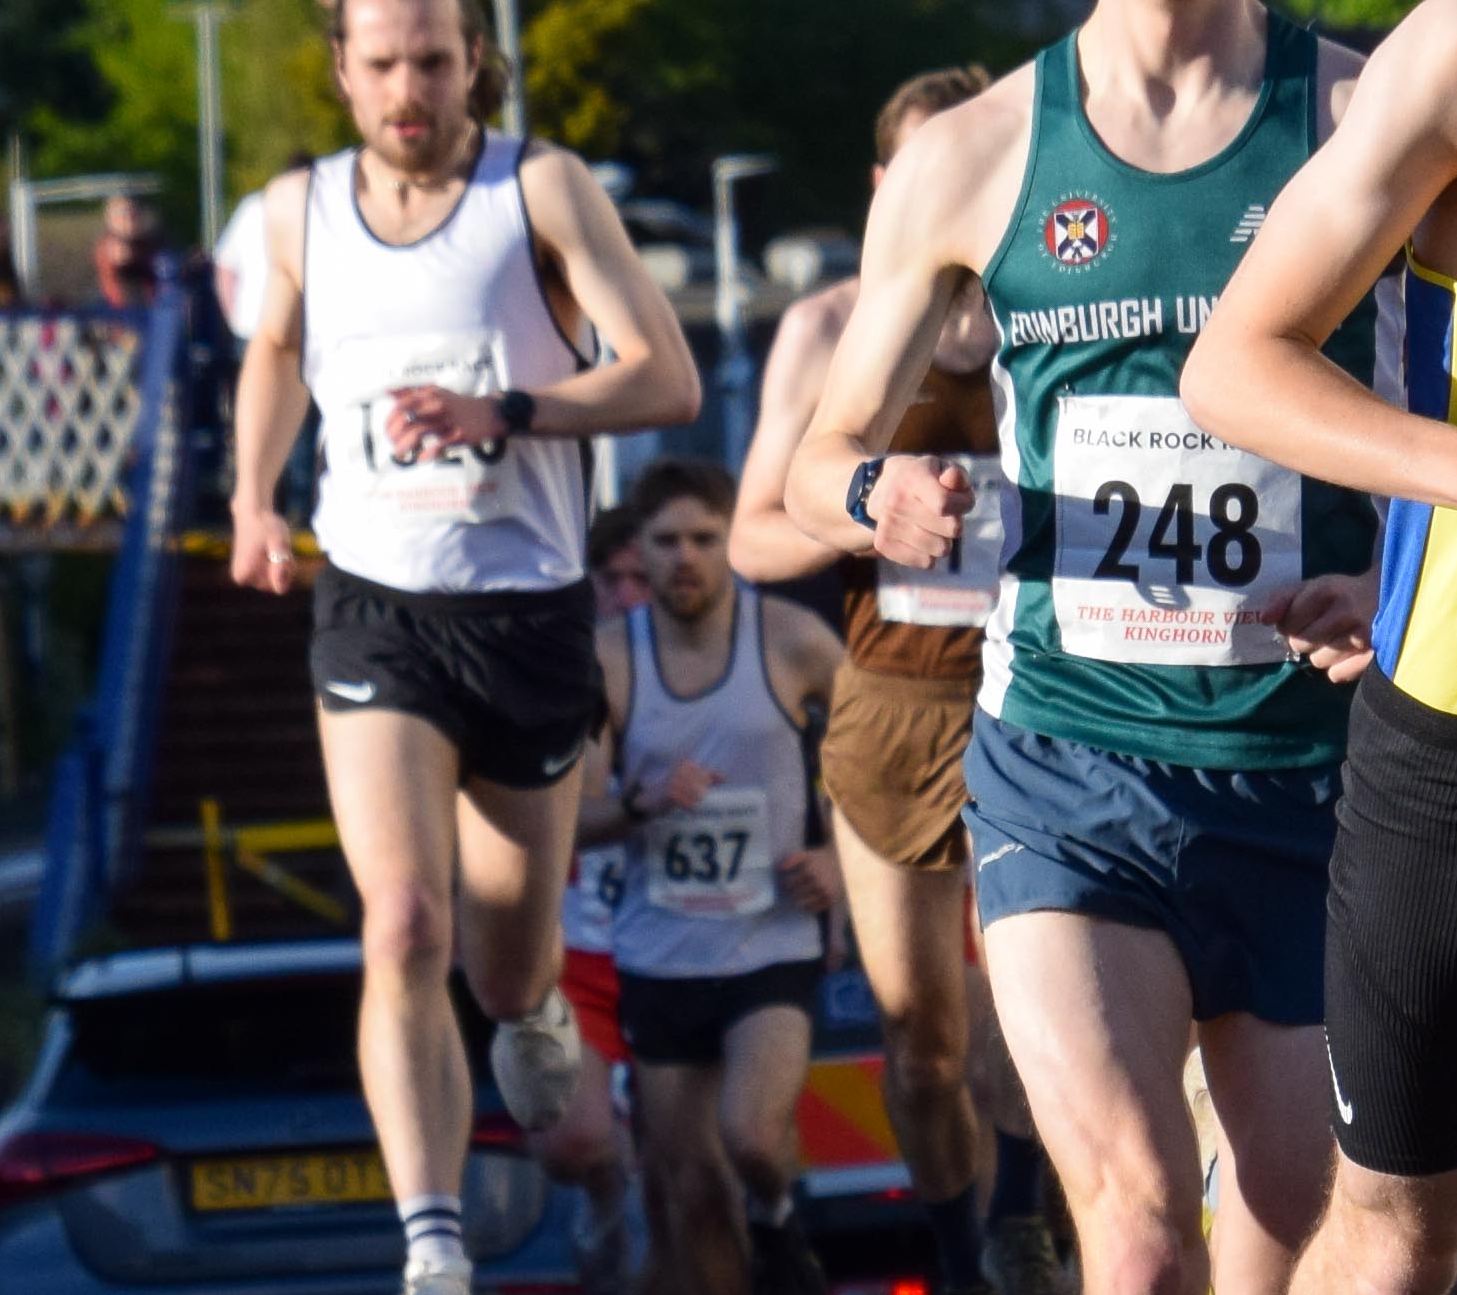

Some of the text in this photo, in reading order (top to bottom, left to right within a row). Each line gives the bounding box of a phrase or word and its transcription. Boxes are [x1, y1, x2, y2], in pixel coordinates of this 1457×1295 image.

[1010, 297, 1163, 347] EDINBURGH
[1073, 428, 1143, 449] BLACK
[1149, 431, 1215, 450] ROCK
[1092, 480, 1263, 587] 248
[1077, 606, 1114, 622] THE
[1121, 606, 1215, 625] HARBOUR
[1124, 626, 1228, 644] KINGHORN
[665, 831, 750, 883] 637
